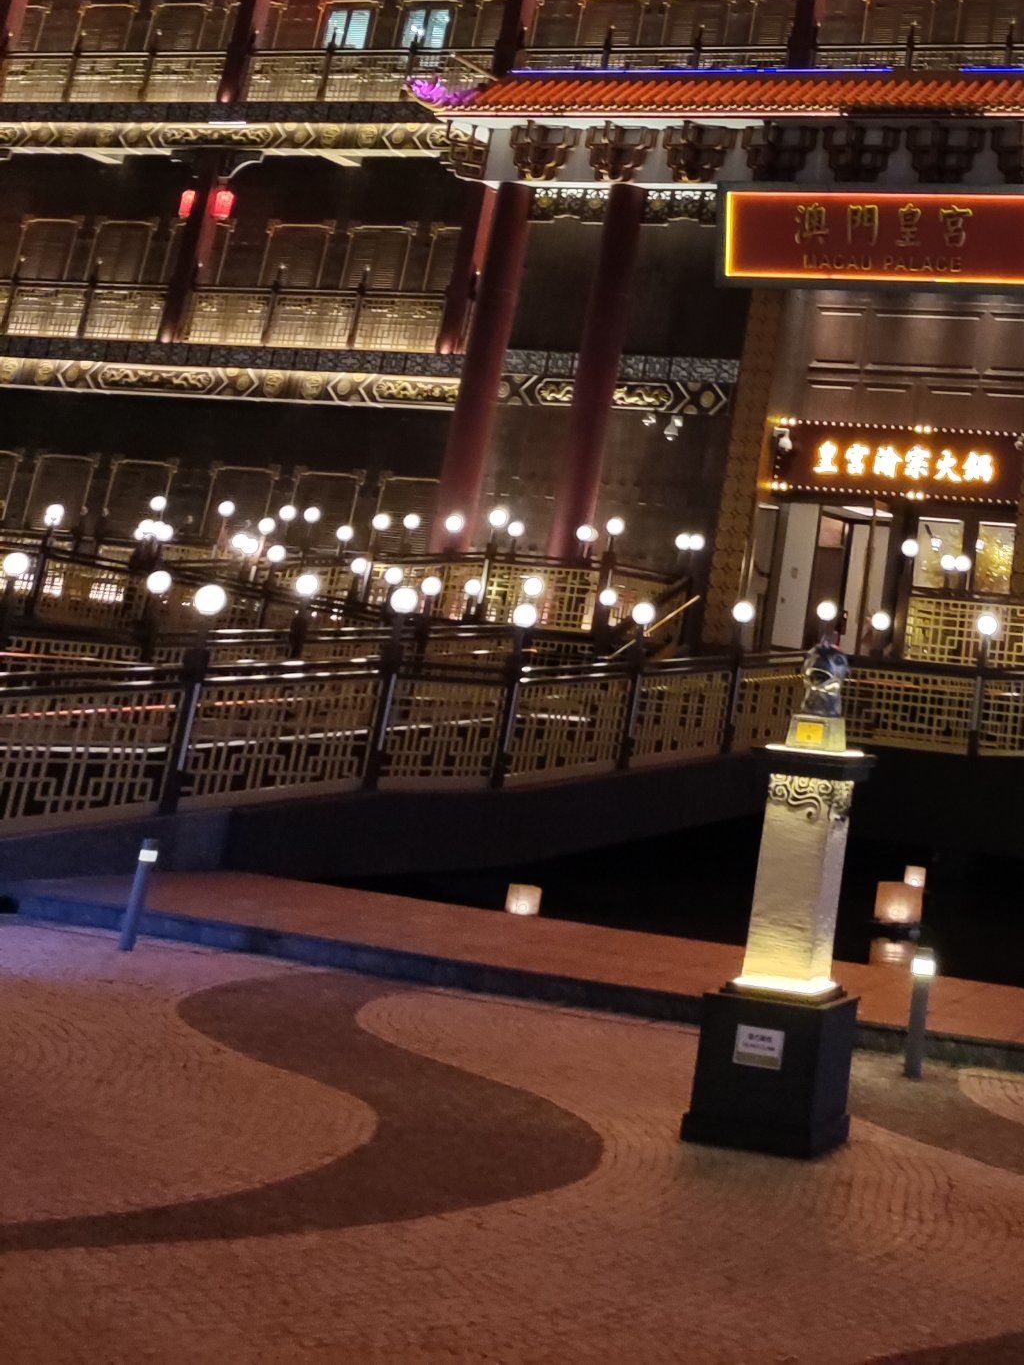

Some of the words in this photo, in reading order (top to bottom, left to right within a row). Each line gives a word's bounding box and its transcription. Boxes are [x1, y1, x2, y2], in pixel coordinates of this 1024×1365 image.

[794, 202, 974, 248] 澳門皇宮
[802, 253, 873, 272] MACAU
[883, 253, 963, 273] PALACE
